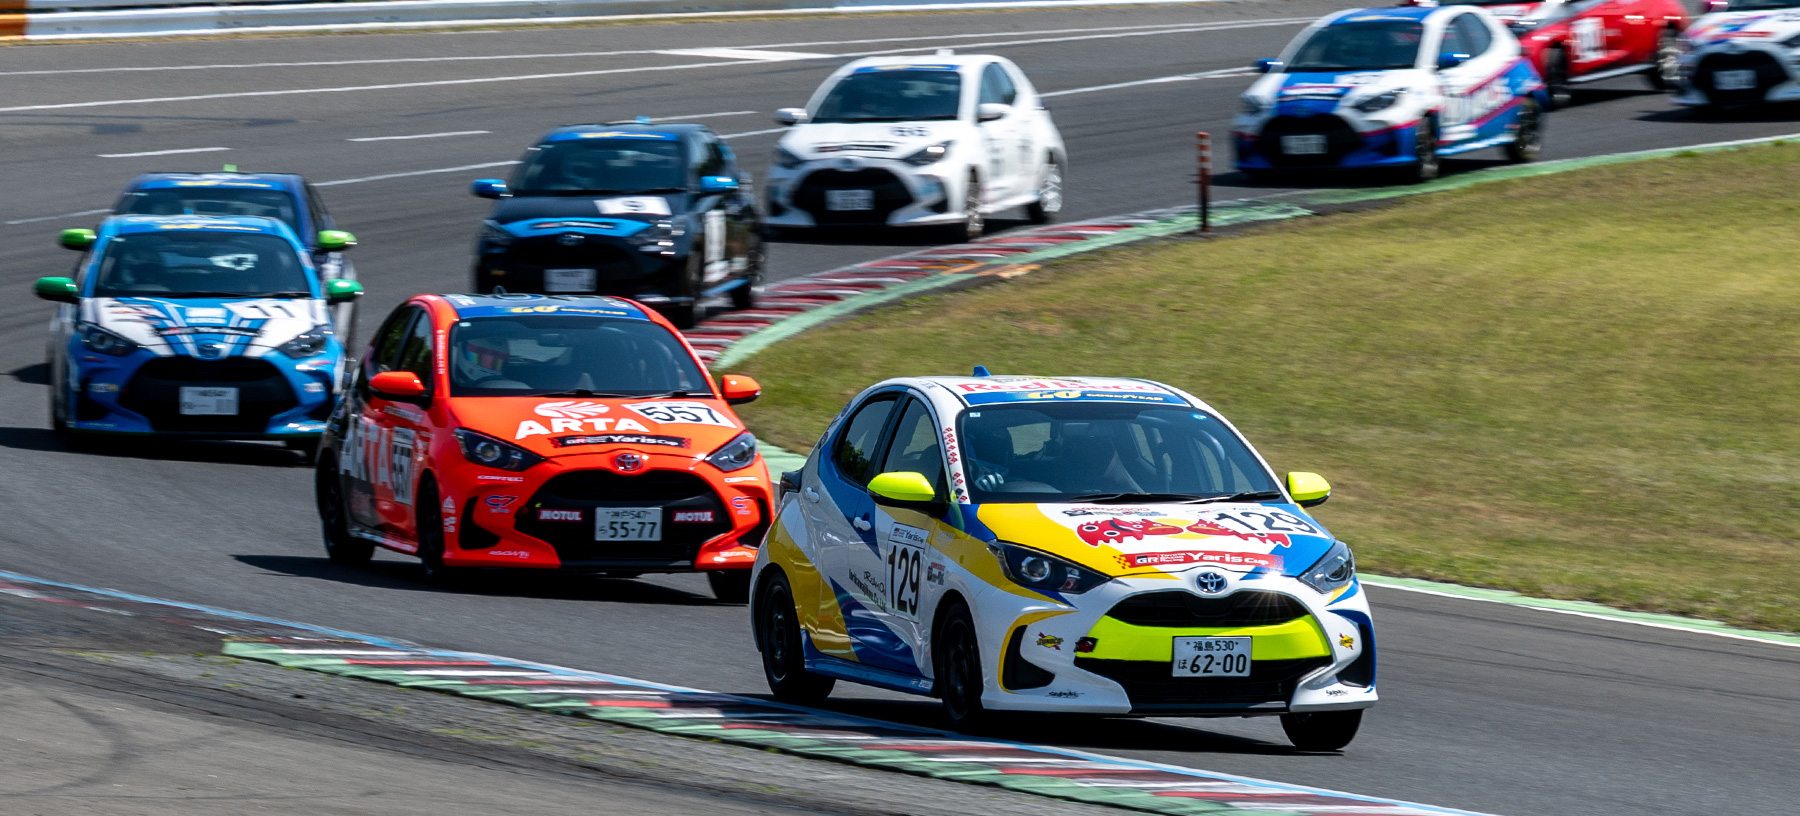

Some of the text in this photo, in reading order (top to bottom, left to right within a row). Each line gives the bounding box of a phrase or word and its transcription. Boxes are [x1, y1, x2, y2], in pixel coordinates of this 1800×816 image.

[956, 381, 1050, 392] Red
[1028, 391, 1081, 399] GO
[639, 405, 721, 423] 557
[514, 417, 651, 440] ARTA
[609, 435, 656, 444] Yaris
[540, 510, 582, 521] MOTUL
[674, 511, 713, 522] MOTUL
[1214, 511, 1318, 534] 129
[609, 521, 657, 538] 55-77
[904, 529, 918, 542] Yaris
[1136, 552, 1269, 566] GR Yaris Cup
[888, 544, 921, 617] 129
[1178, 653, 1247, 674] ほ 62-00
